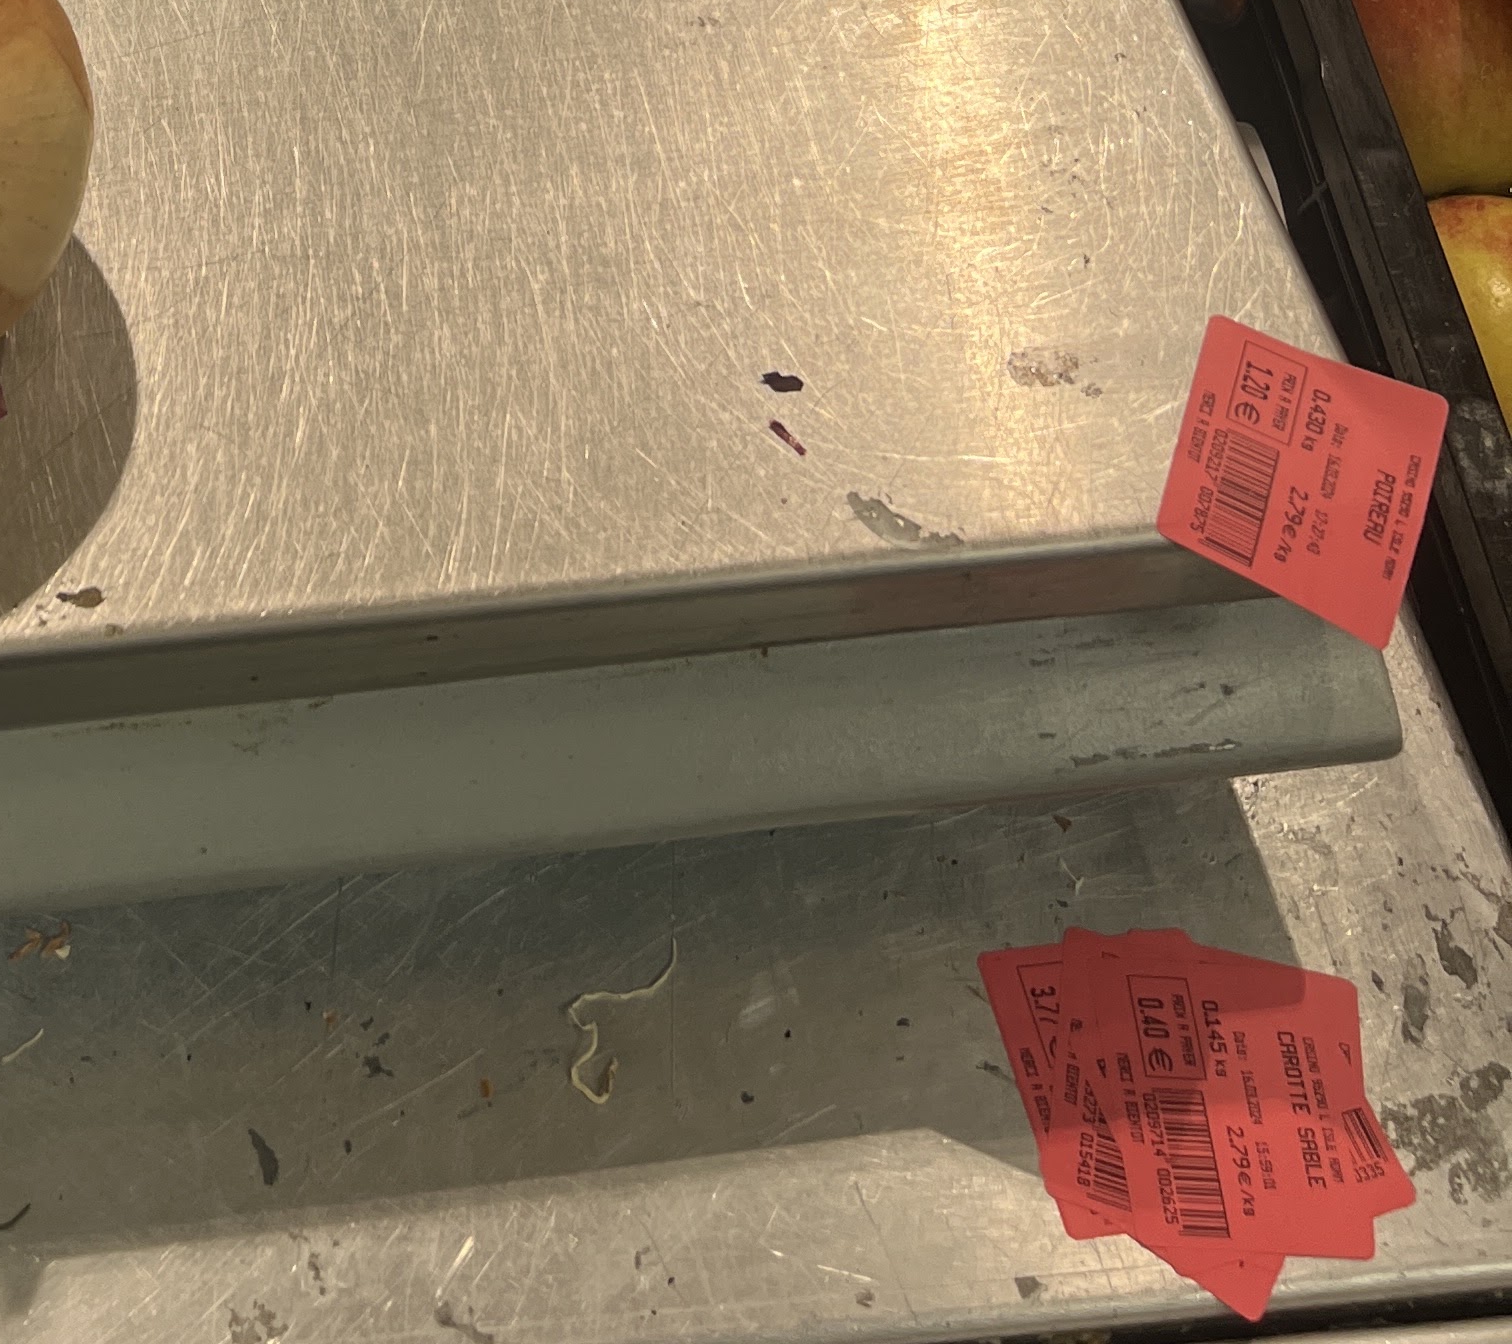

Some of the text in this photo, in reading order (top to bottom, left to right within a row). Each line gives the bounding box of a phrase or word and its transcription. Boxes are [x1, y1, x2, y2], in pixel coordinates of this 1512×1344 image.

[1234, 361, 1273, 425] 1.20 €
[1307, 388, 1331, 436] 0.430
[1364, 469, 1396, 547] POIREAU
[1137, 997, 1173, 1073] 0.40 €
[1202, 1000, 1228, 1055] 0.145
[1277, 1031, 1310, 1115] CAROTTE
[1296, 1127, 1327, 1189] SABLE
